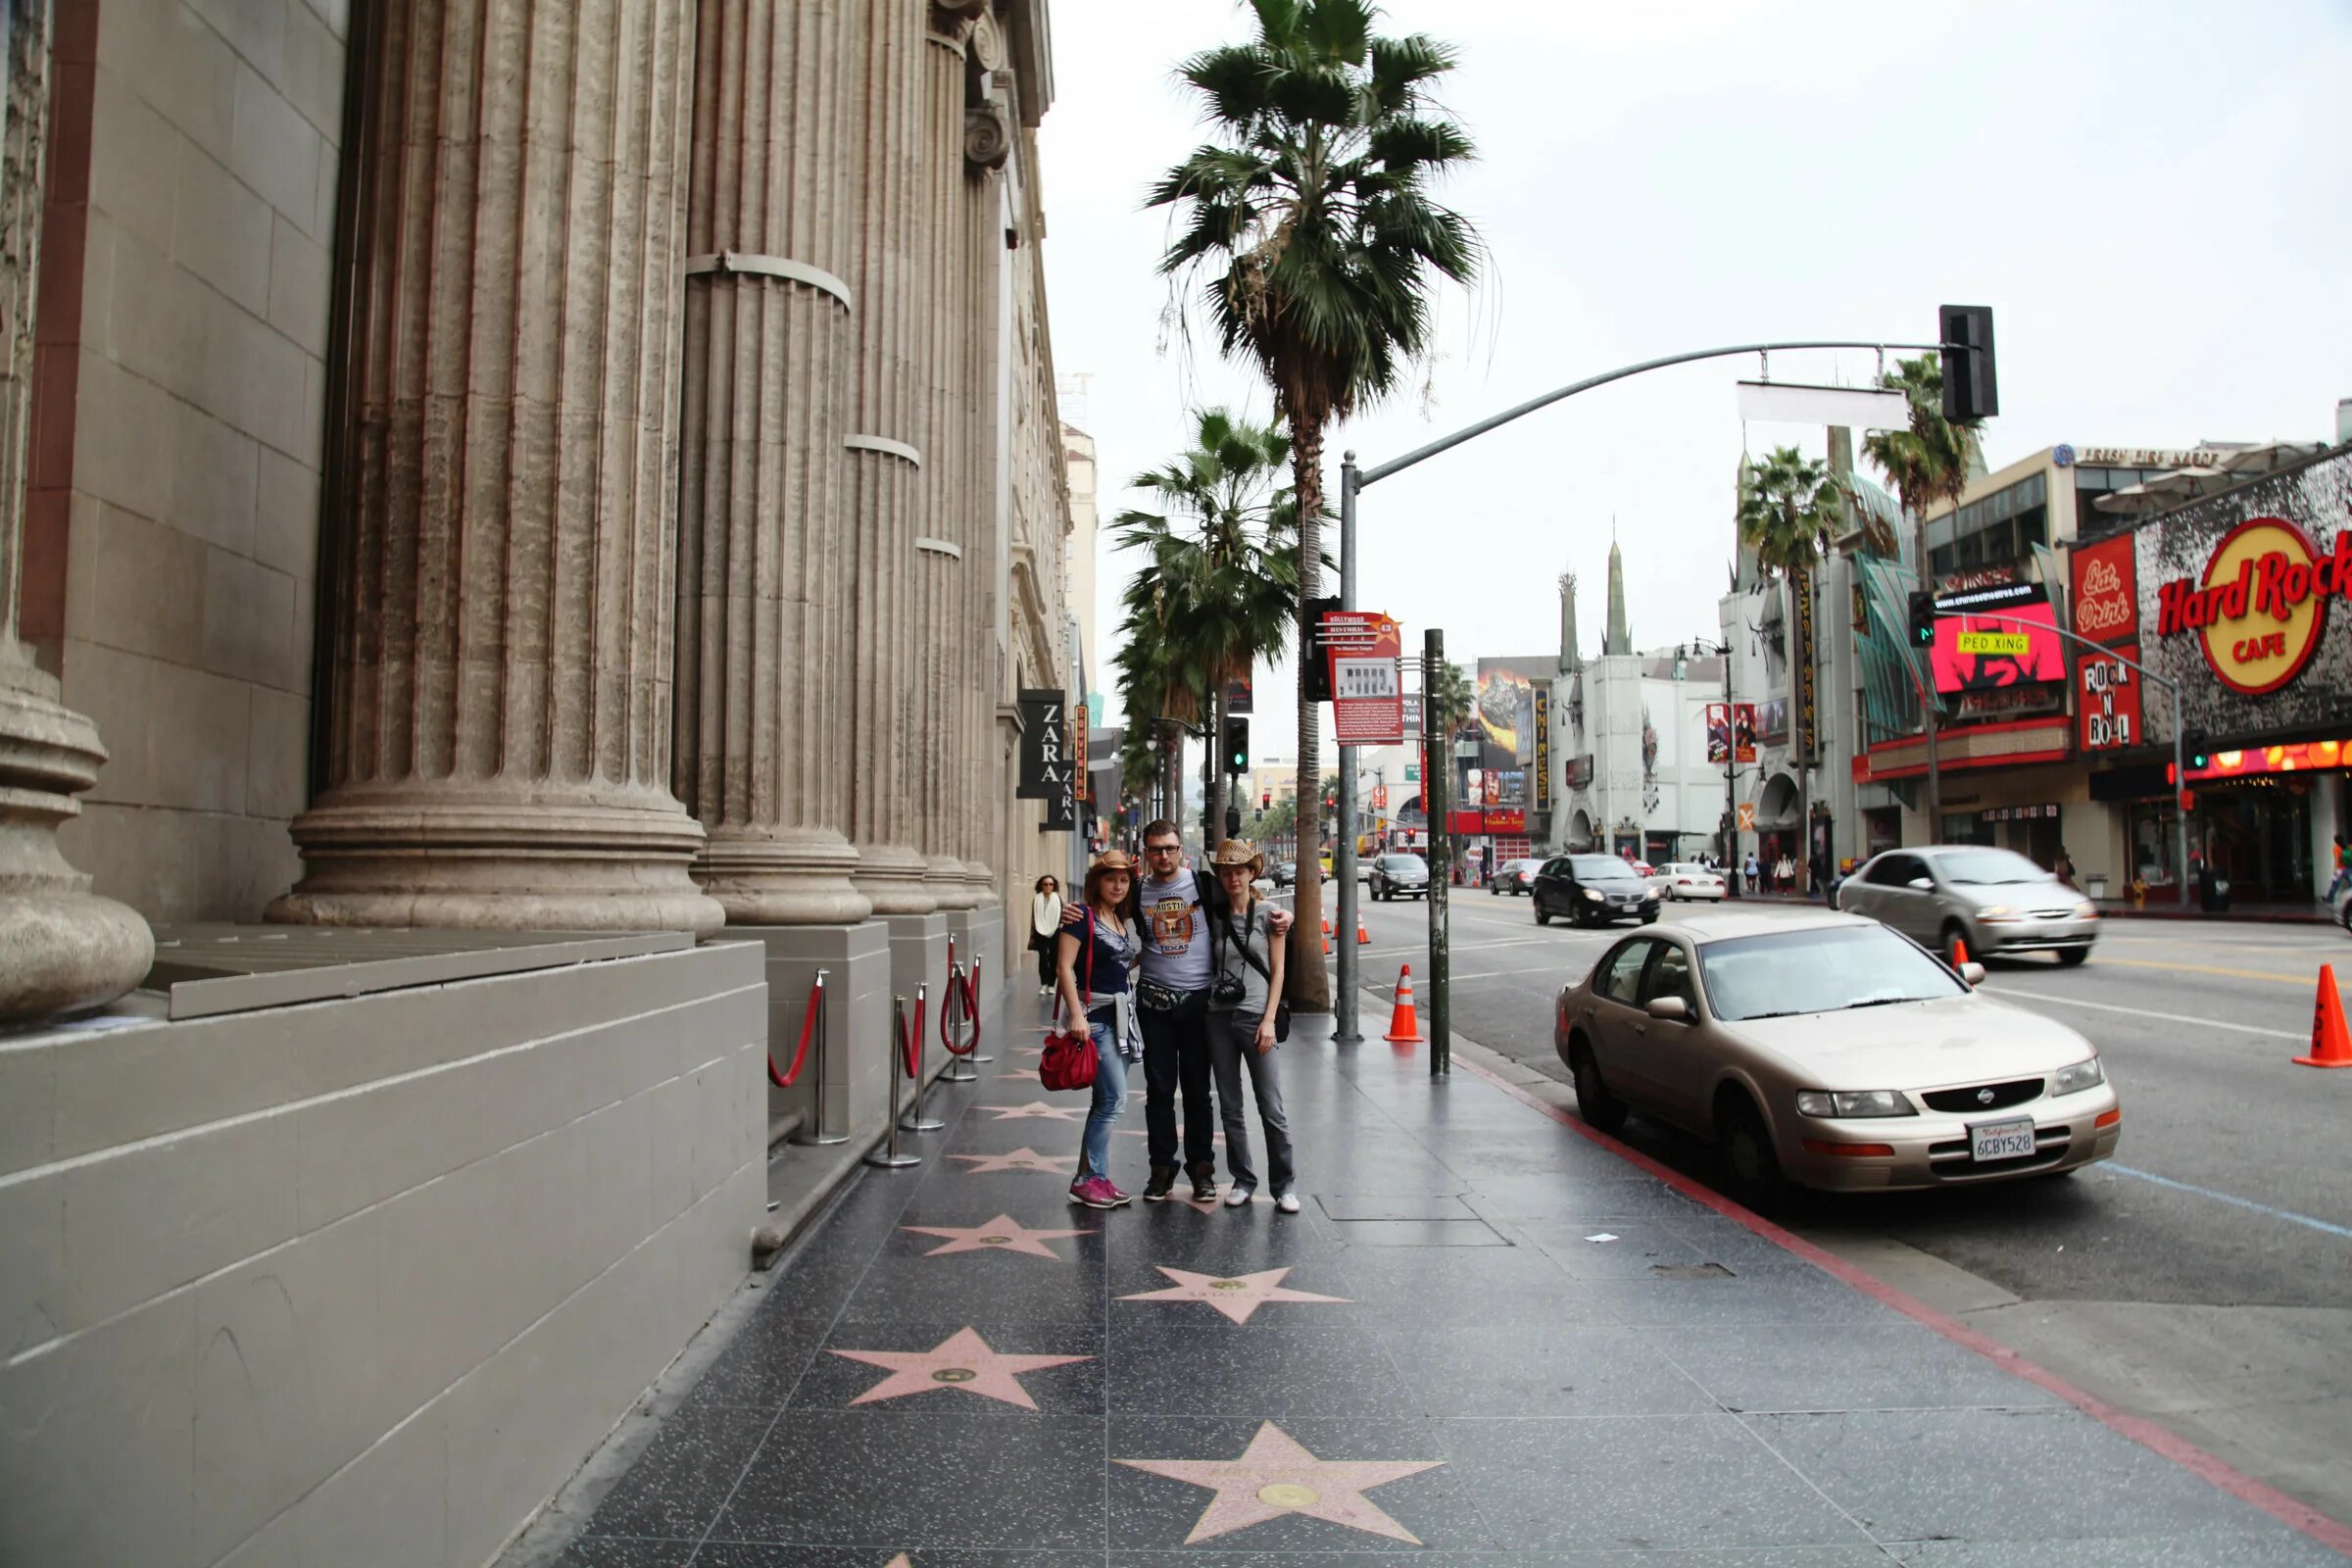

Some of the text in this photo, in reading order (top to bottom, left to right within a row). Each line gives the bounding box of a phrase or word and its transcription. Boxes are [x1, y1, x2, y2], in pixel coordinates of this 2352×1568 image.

[2158, 530, 2352, 637] Hard Rock
[1963, 636, 2024, 651] PED XING
[2232, 632, 2286, 664] CAFE
[2084, 660, 2129, 697] ROCK
[2102, 693, 2112, 716] N
[1041, 705, 1059, 782] ZARA
[2088, 713, 2129, 746] ROLL
[1061, 769, 1072, 820] ZARA
[1156, 903, 1186, 911] AUSTIN
[1160, 943, 1189, 952] TEXAS
[1978, 1135, 2031, 1156] 6CBY528
